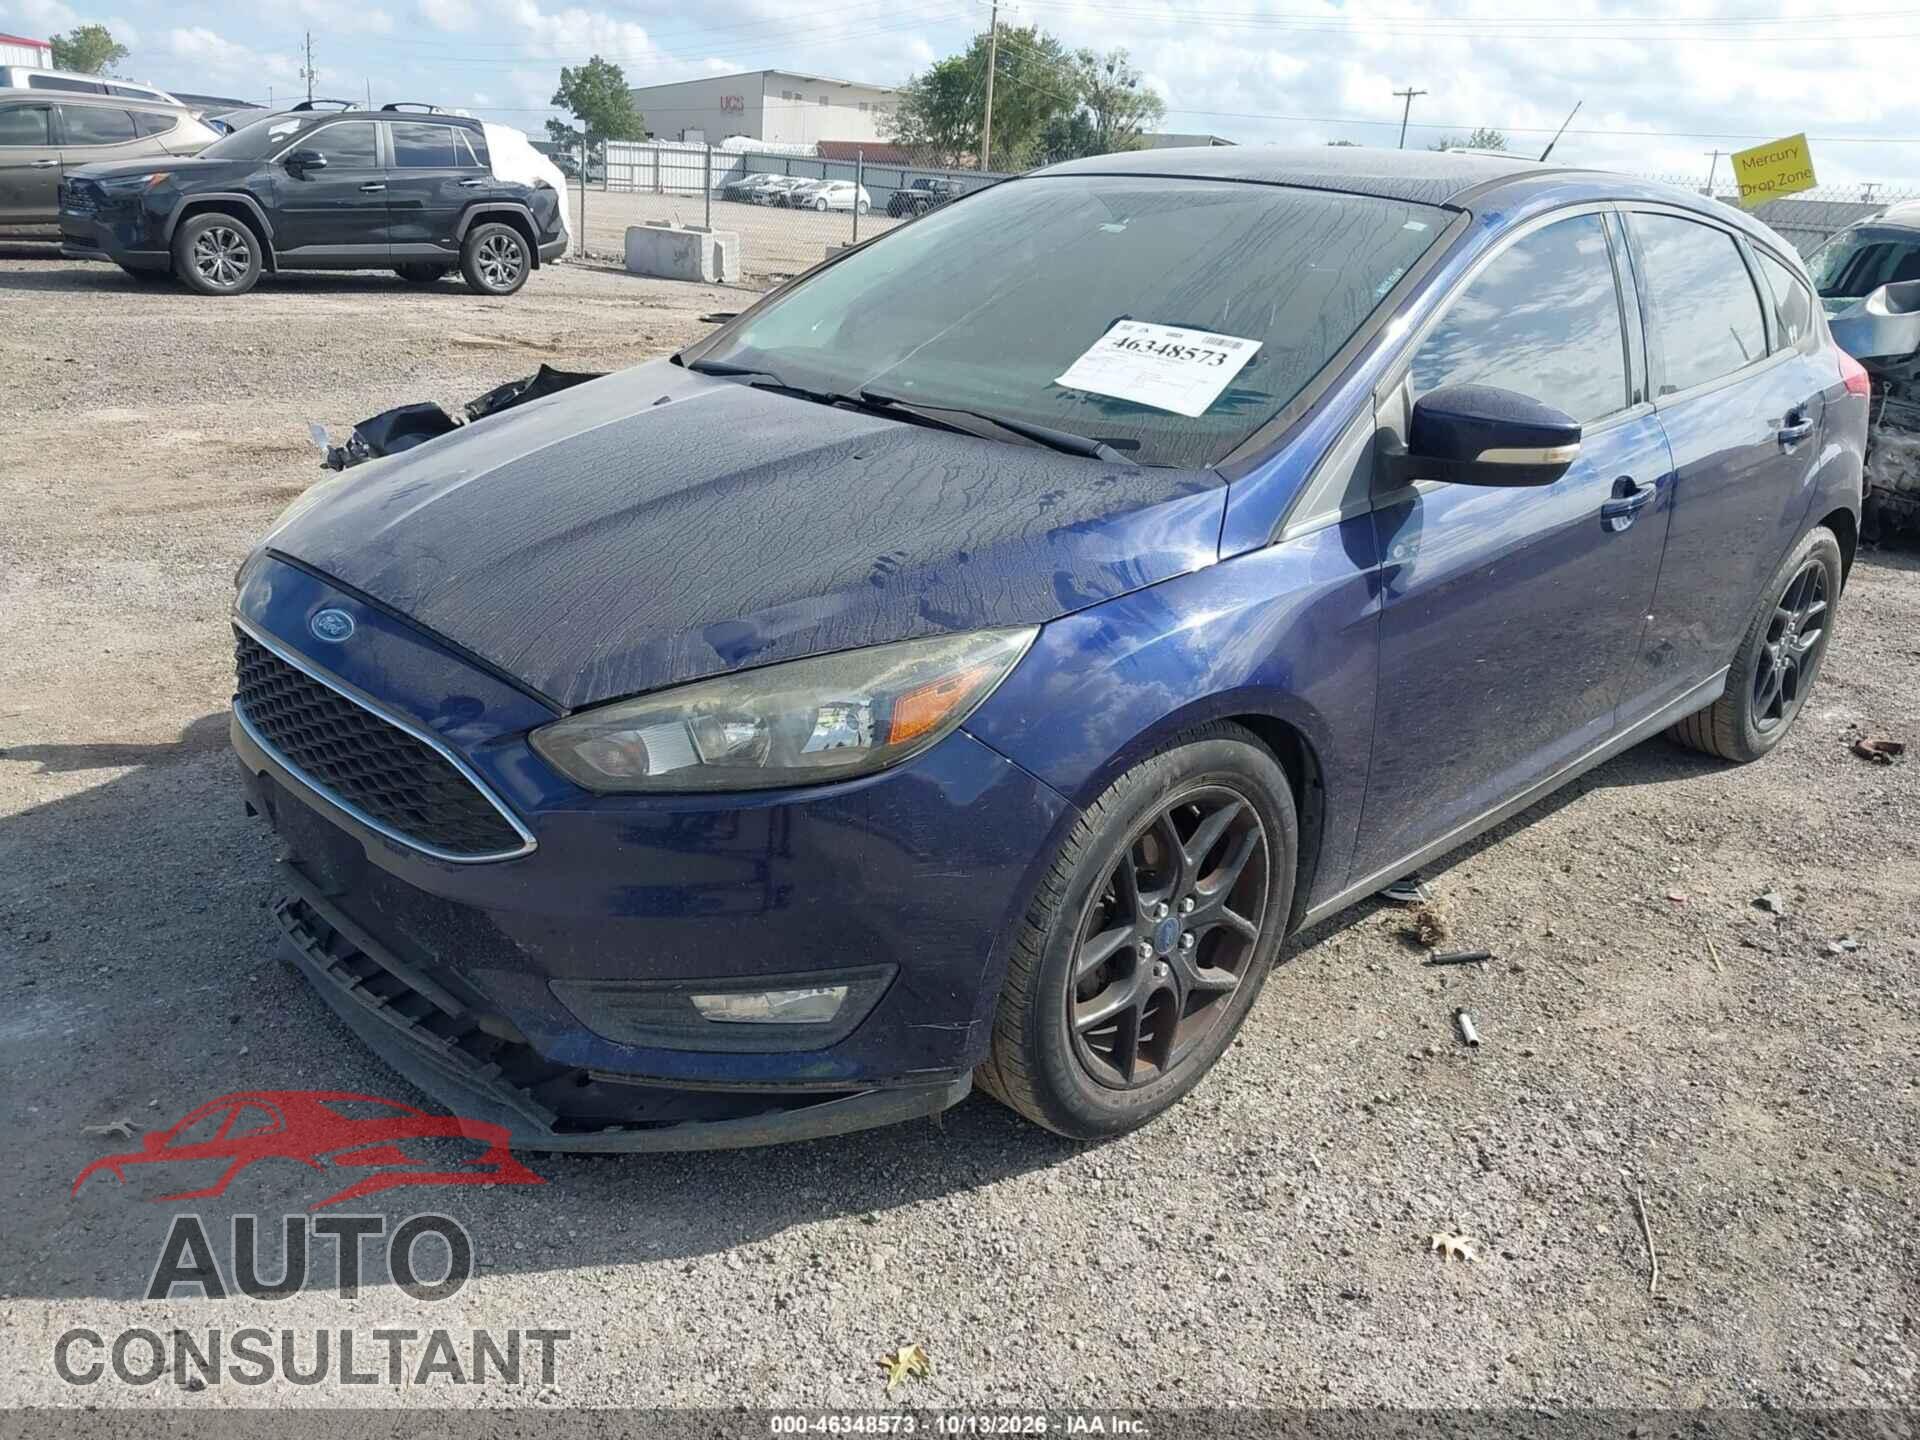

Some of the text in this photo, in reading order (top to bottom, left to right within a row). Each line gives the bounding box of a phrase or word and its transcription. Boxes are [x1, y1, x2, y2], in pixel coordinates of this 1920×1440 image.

[1742, 147, 1798, 171] Mercury
[1741, 168, 1812, 197] Drop Zone
[1112, 336, 1228, 367] 46348573
